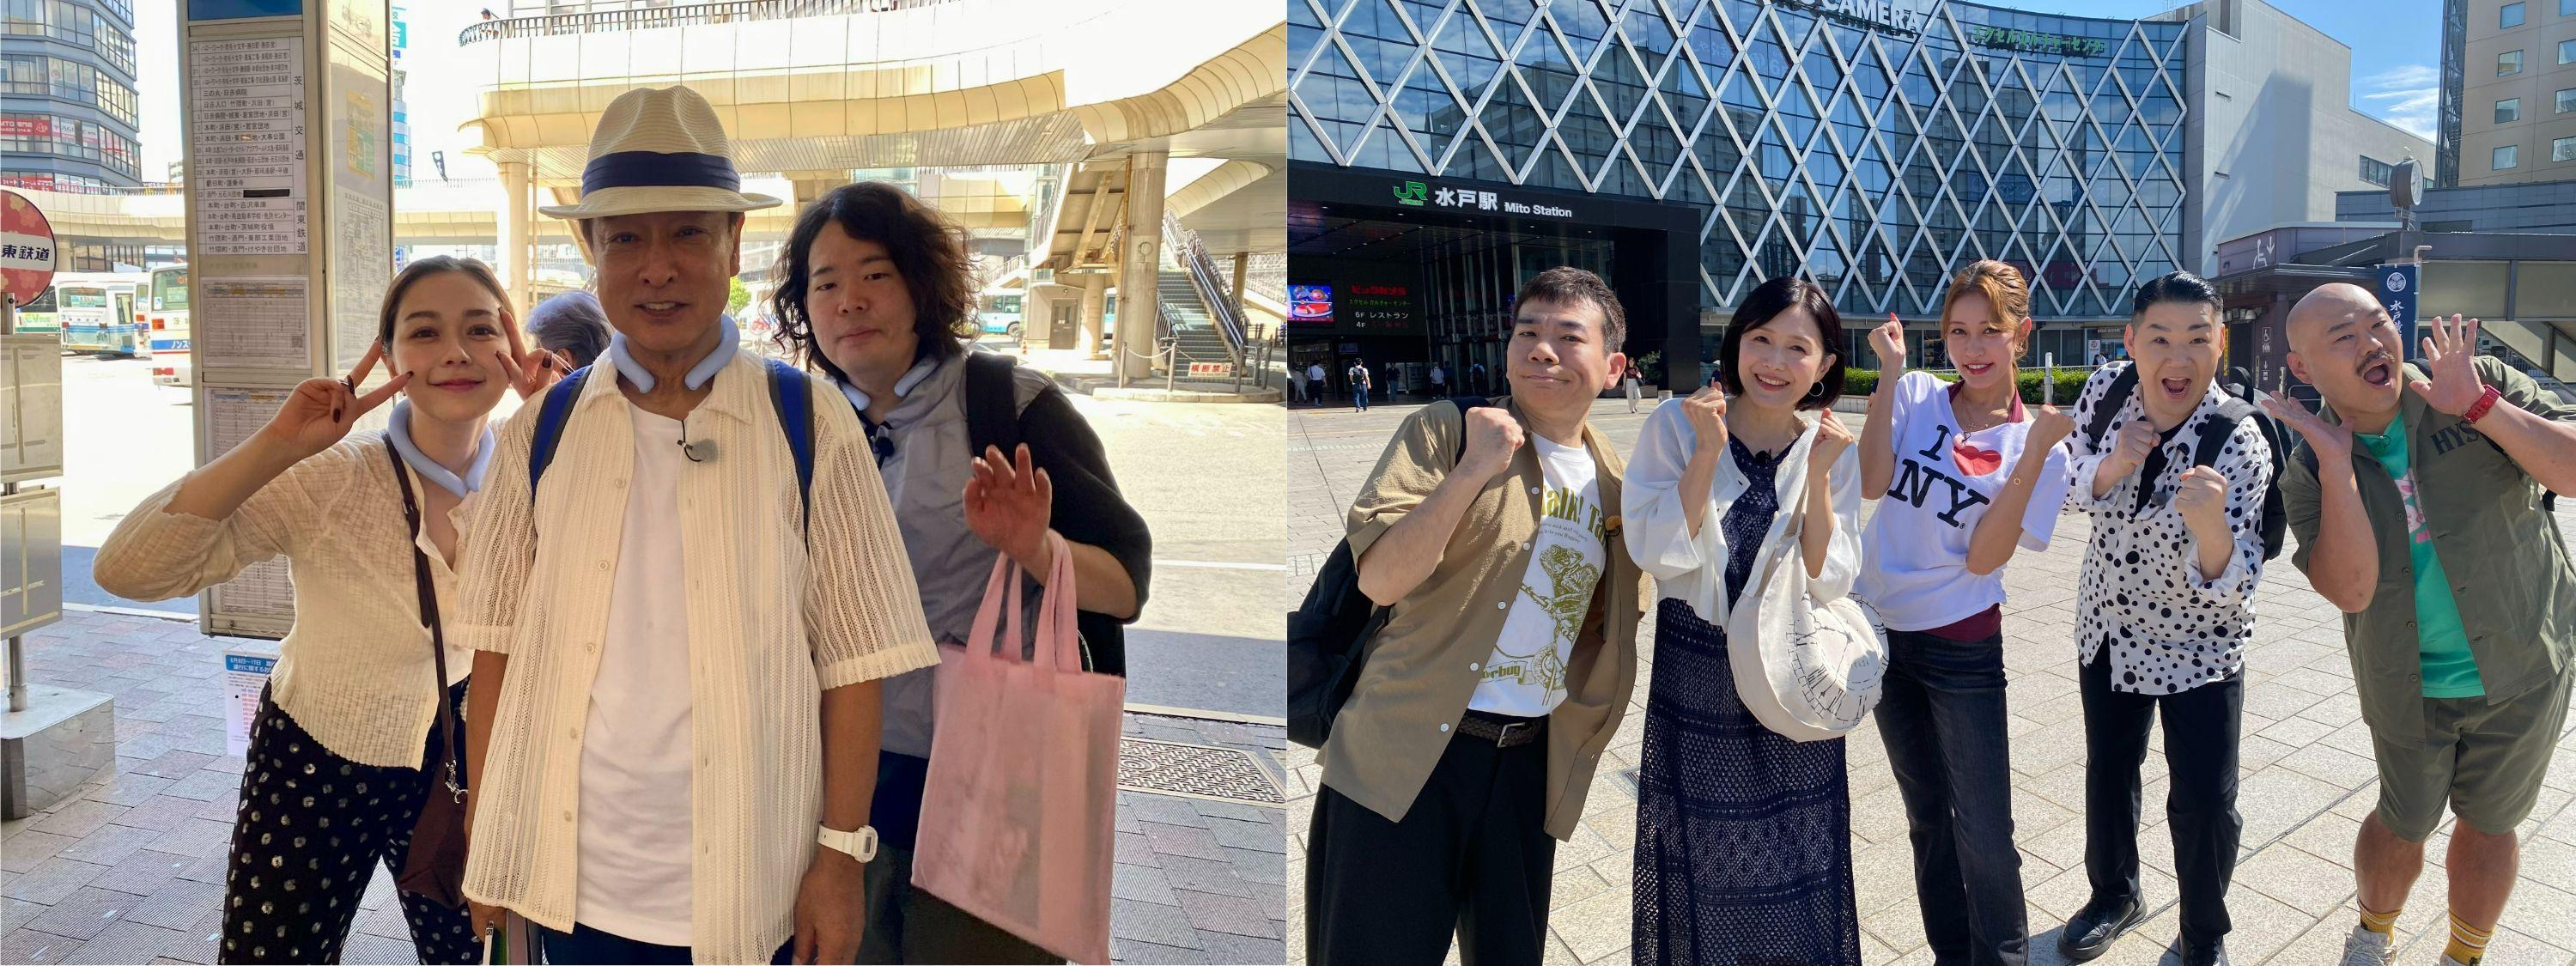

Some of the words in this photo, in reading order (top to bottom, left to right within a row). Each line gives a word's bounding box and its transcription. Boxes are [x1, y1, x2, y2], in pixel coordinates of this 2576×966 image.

[294, 76, 304, 161] 茨城交通
[1393, 181, 1428, 201] JR
[1435, 187, 1498, 211] 水戸駅
[1504, 201, 1531, 214] Mito
[1532, 204, 1572, 218] Station
[295, 201, 307, 252] 関東鉄道
[1, 245, 50, 261] 東鉄道
[2390, 300, 2404, 337] 水戸黄
[172, 340, 190, 349] ノンス
[1191, 364, 1230, 373] 横断禁止
[1918, 424, 1952, 461] I
[1886, 458, 1990, 528] NY
[1588, 502, 1607, 553] Ta
